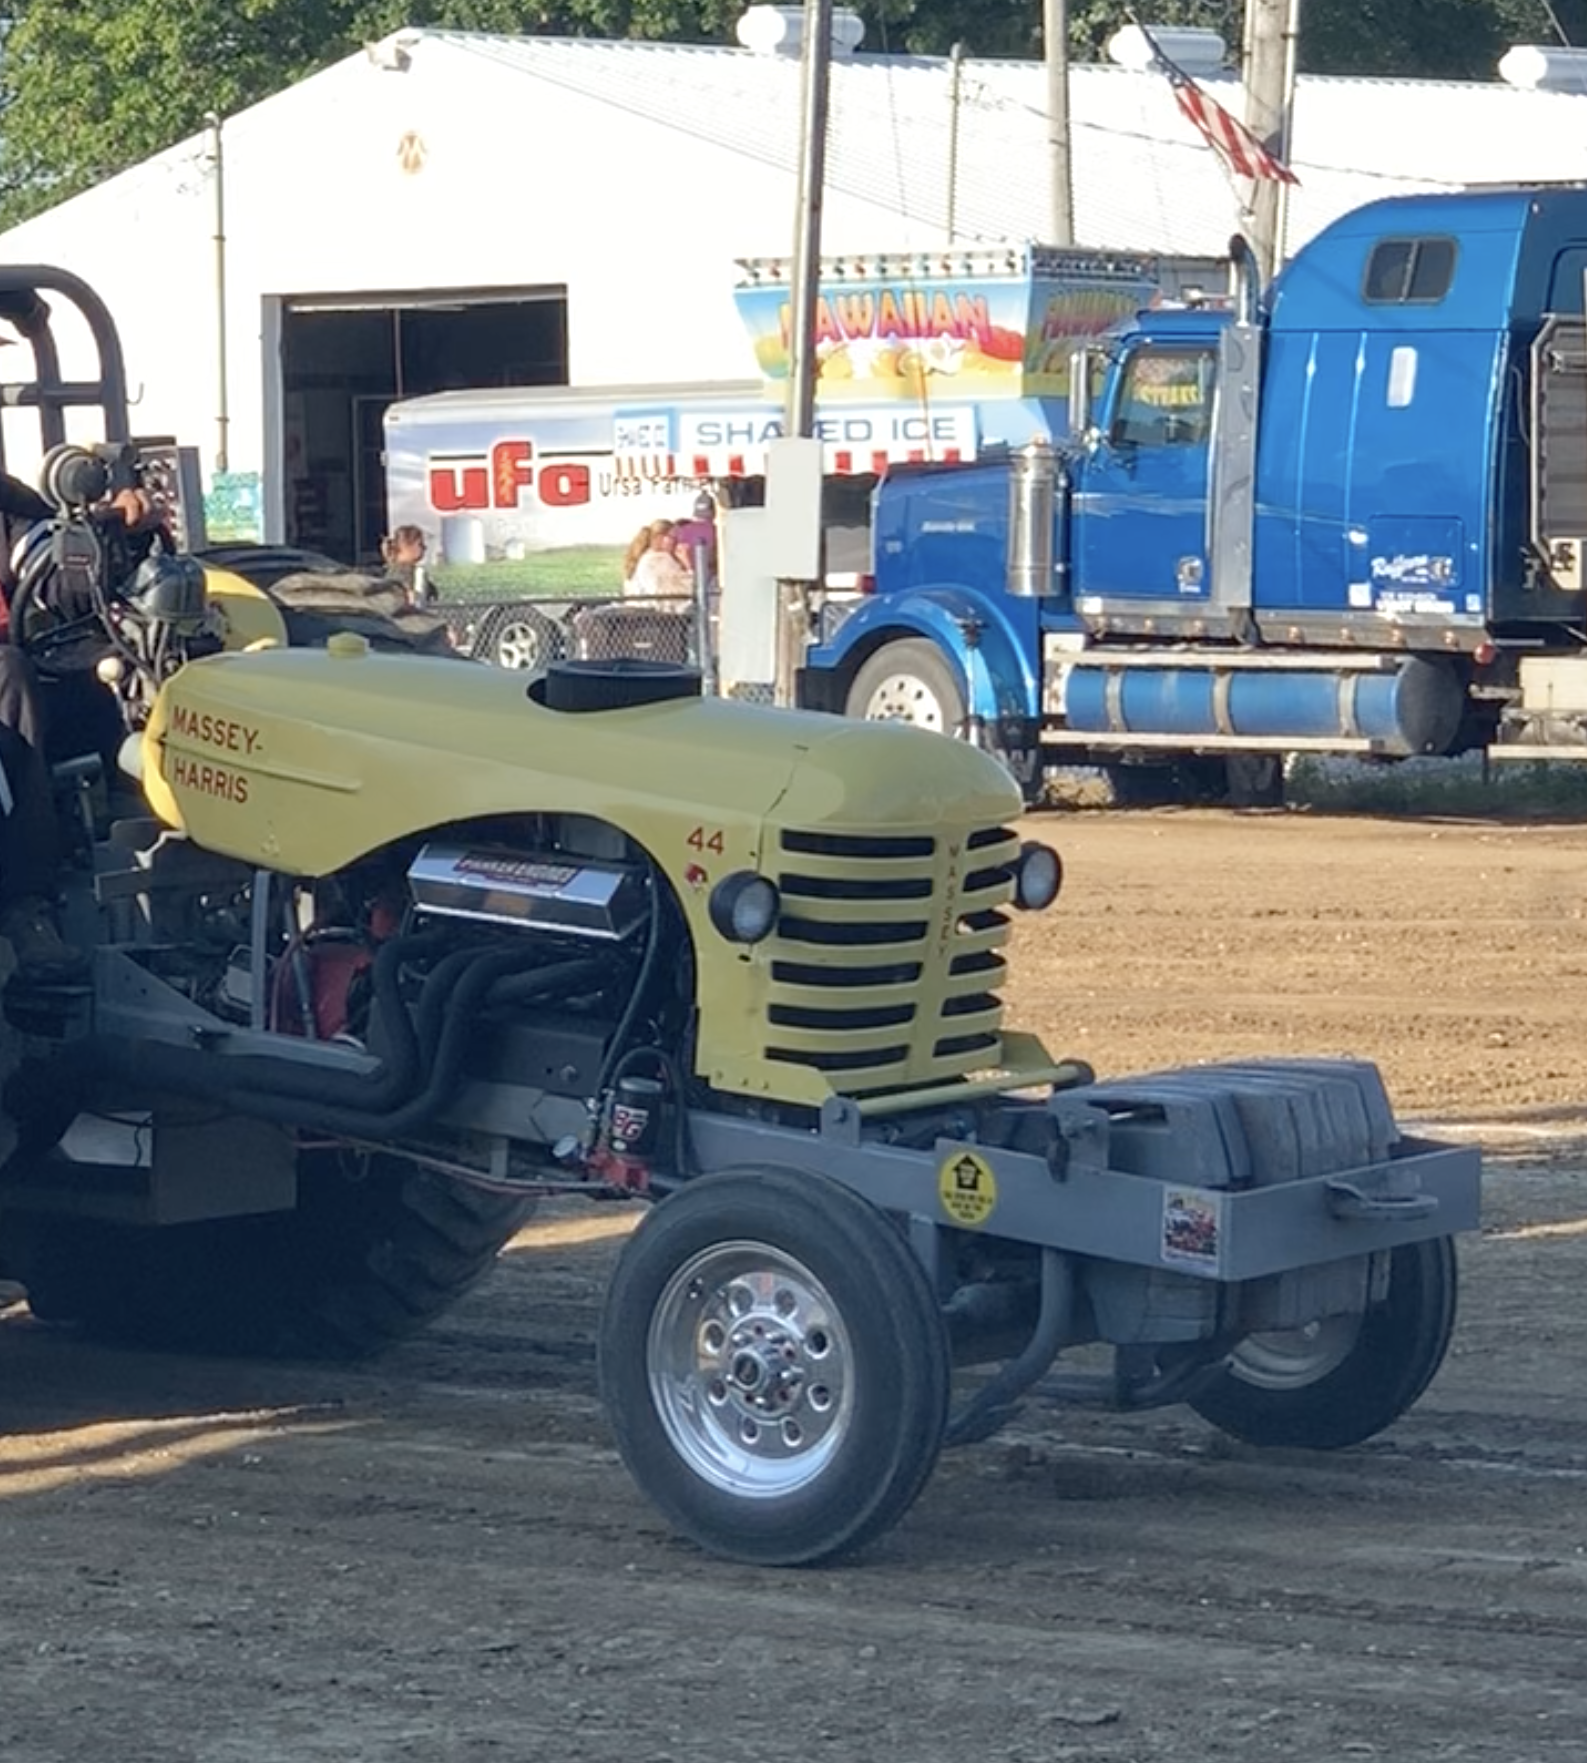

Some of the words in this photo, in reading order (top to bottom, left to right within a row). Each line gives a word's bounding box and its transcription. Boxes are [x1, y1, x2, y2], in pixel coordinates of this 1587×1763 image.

[696, 418, 866, 446] SHAED
[892, 416, 956, 441] ICE
[173, 705, 264, 754] MASSEY-
[174, 758, 248, 804] HARRIS
[687, 826, 724, 855] 44
